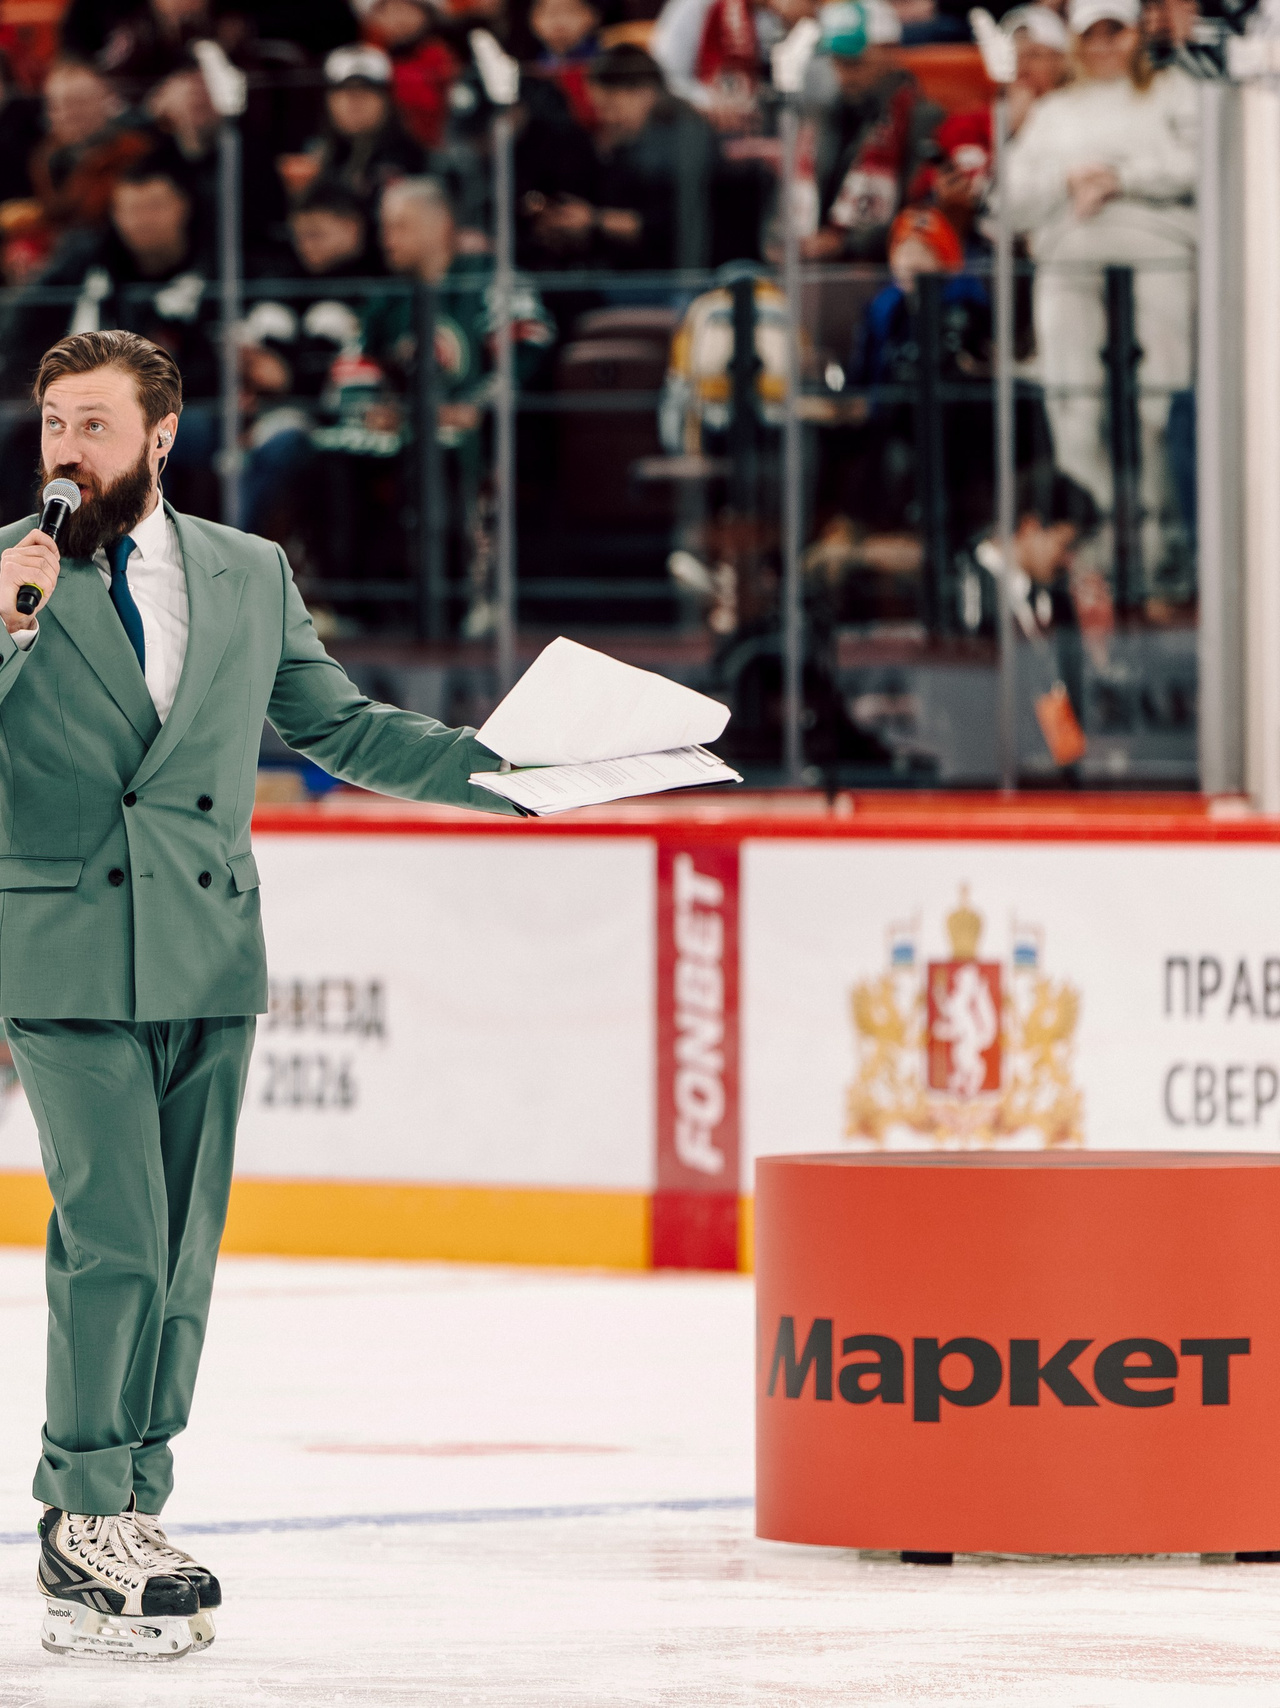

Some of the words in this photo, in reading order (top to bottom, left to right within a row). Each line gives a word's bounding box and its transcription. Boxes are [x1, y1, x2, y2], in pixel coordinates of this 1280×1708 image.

[672, 851, 725, 1176] FONBET
[263, 1053, 355, 1110] 2026
[768, 1315, 1251, 1423] Маркет
[48, 1608, 72, 1618] Reebok
